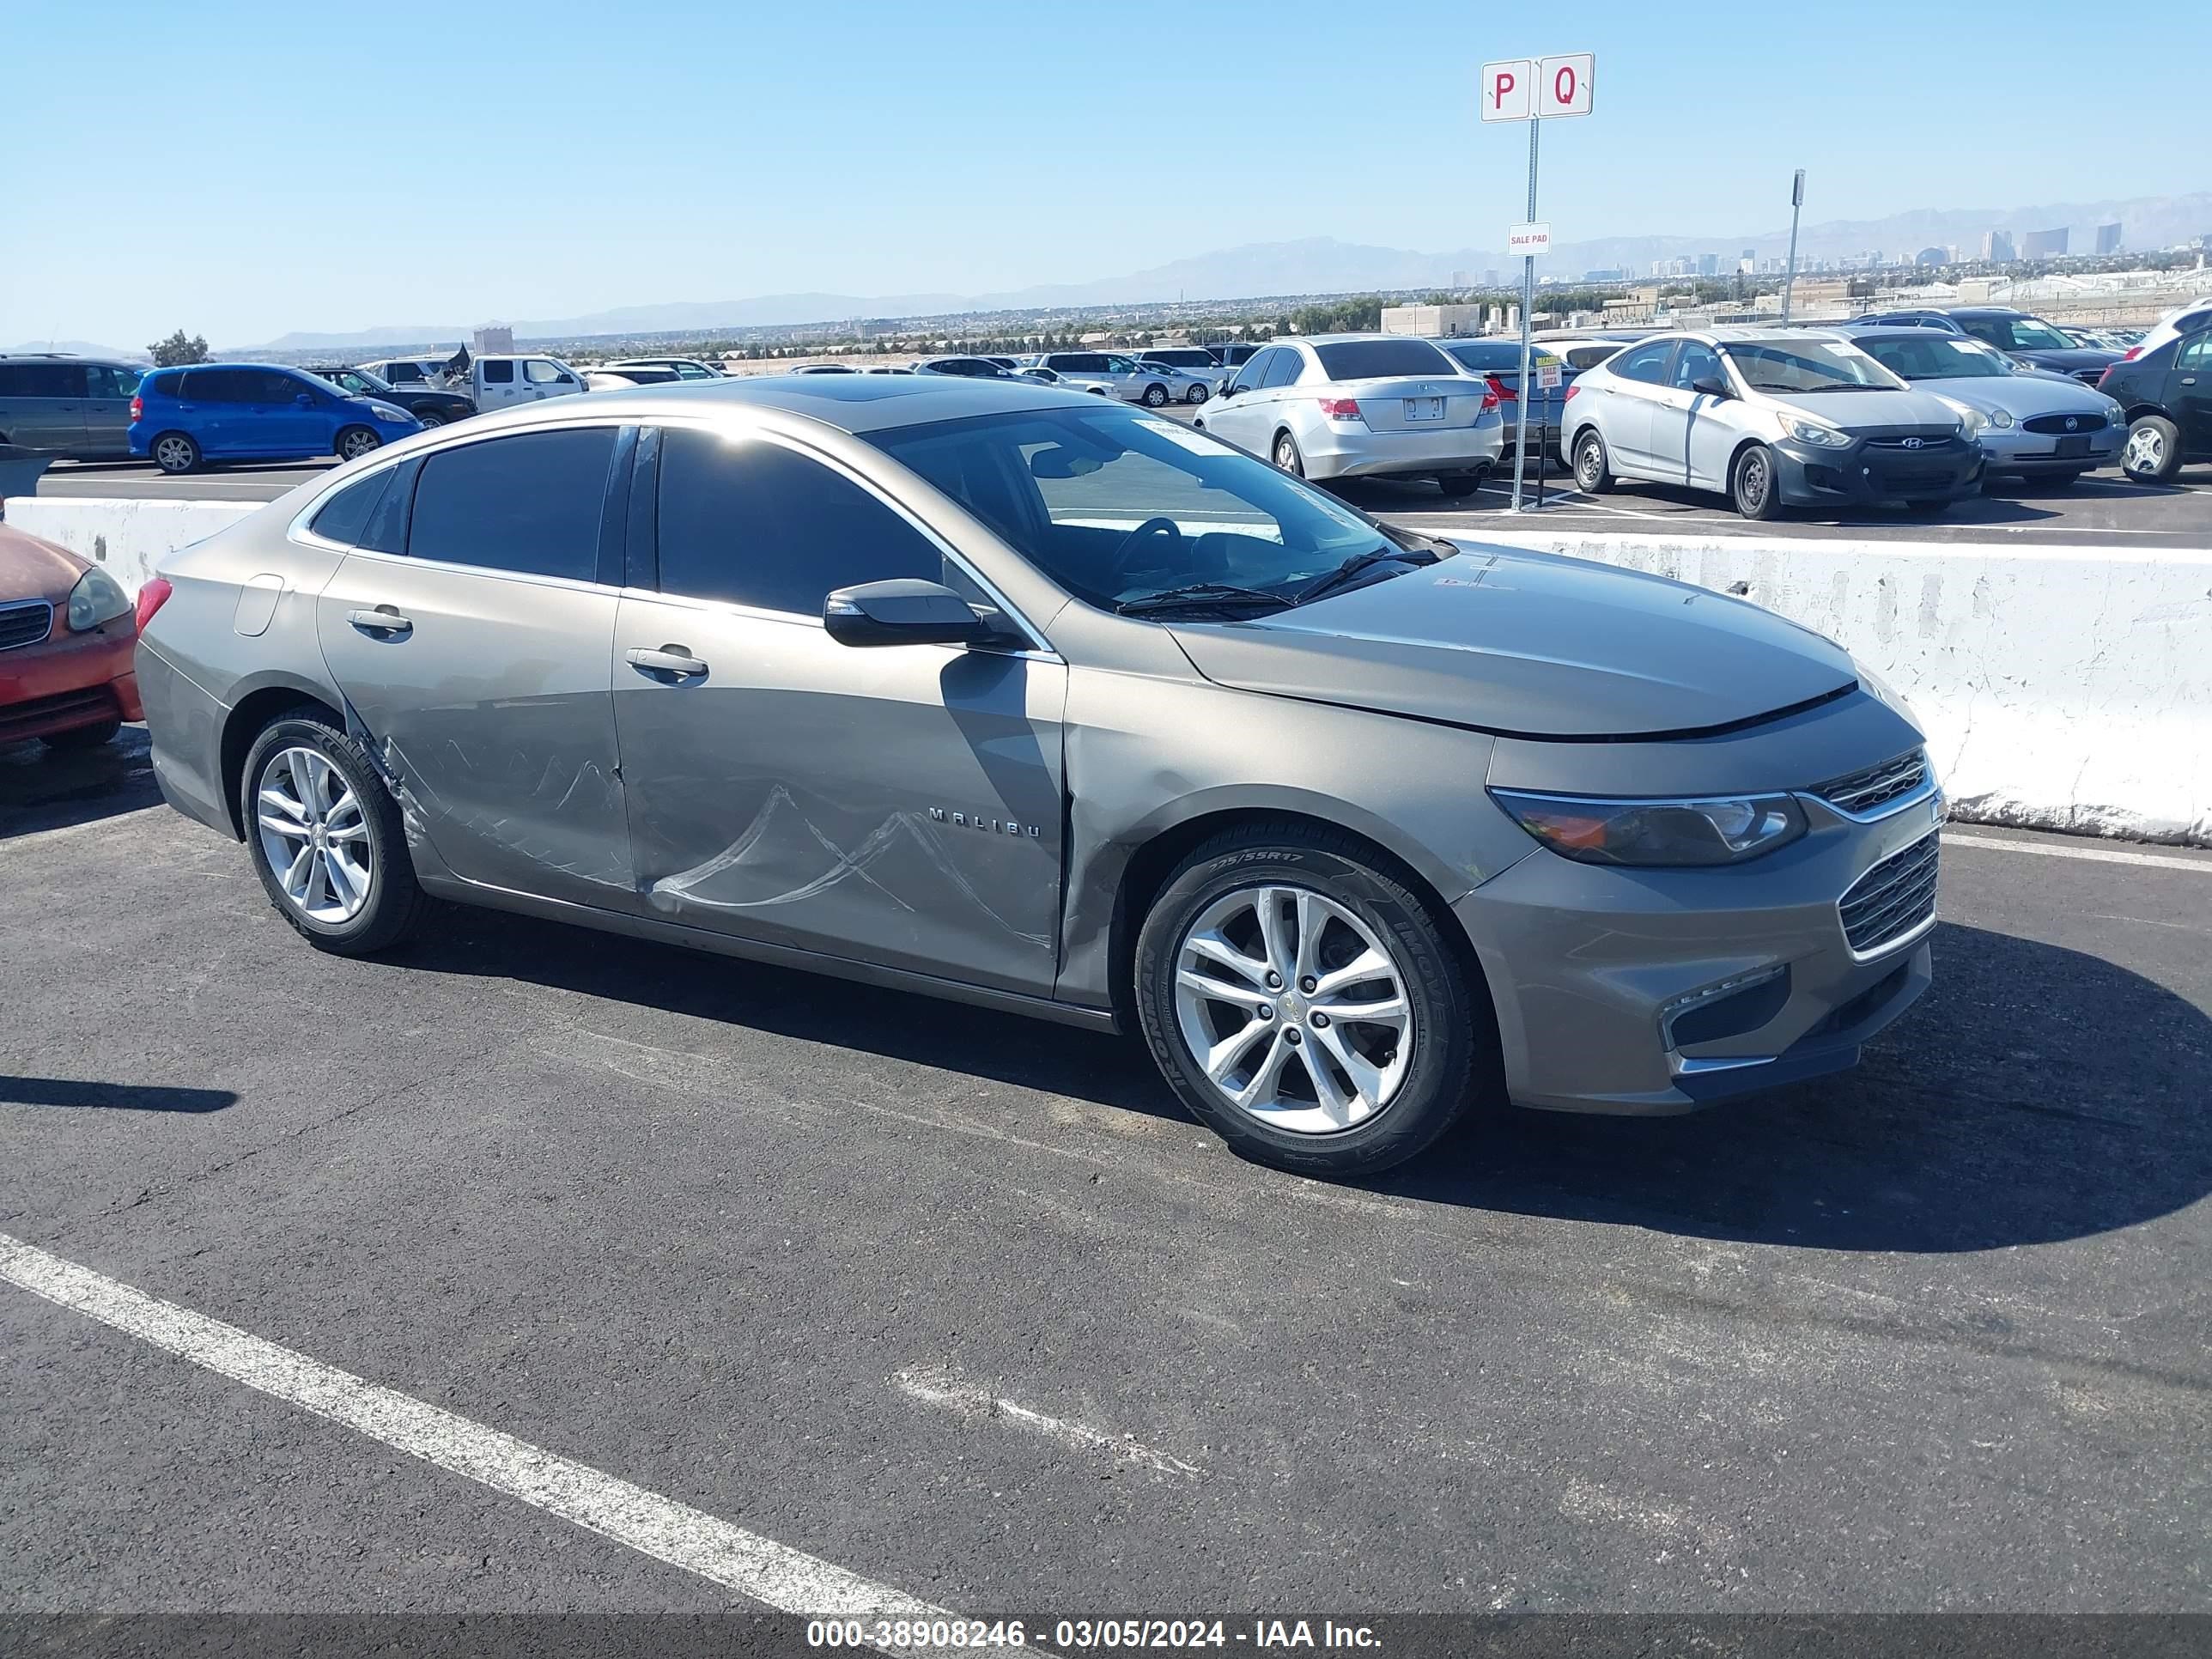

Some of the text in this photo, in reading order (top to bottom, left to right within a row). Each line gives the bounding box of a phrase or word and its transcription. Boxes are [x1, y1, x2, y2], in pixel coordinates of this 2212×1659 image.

[1496, 66, 1575, 109] P Q
[1511, 234, 1547, 245] SALE PAD
[1542, 367, 1556, 375] SALE
[928, 806, 1041, 838] MALIBU
[1209, 851, 1305, 874] 225/55R17
[1141, 946, 1188, 1087] IRONMAN
